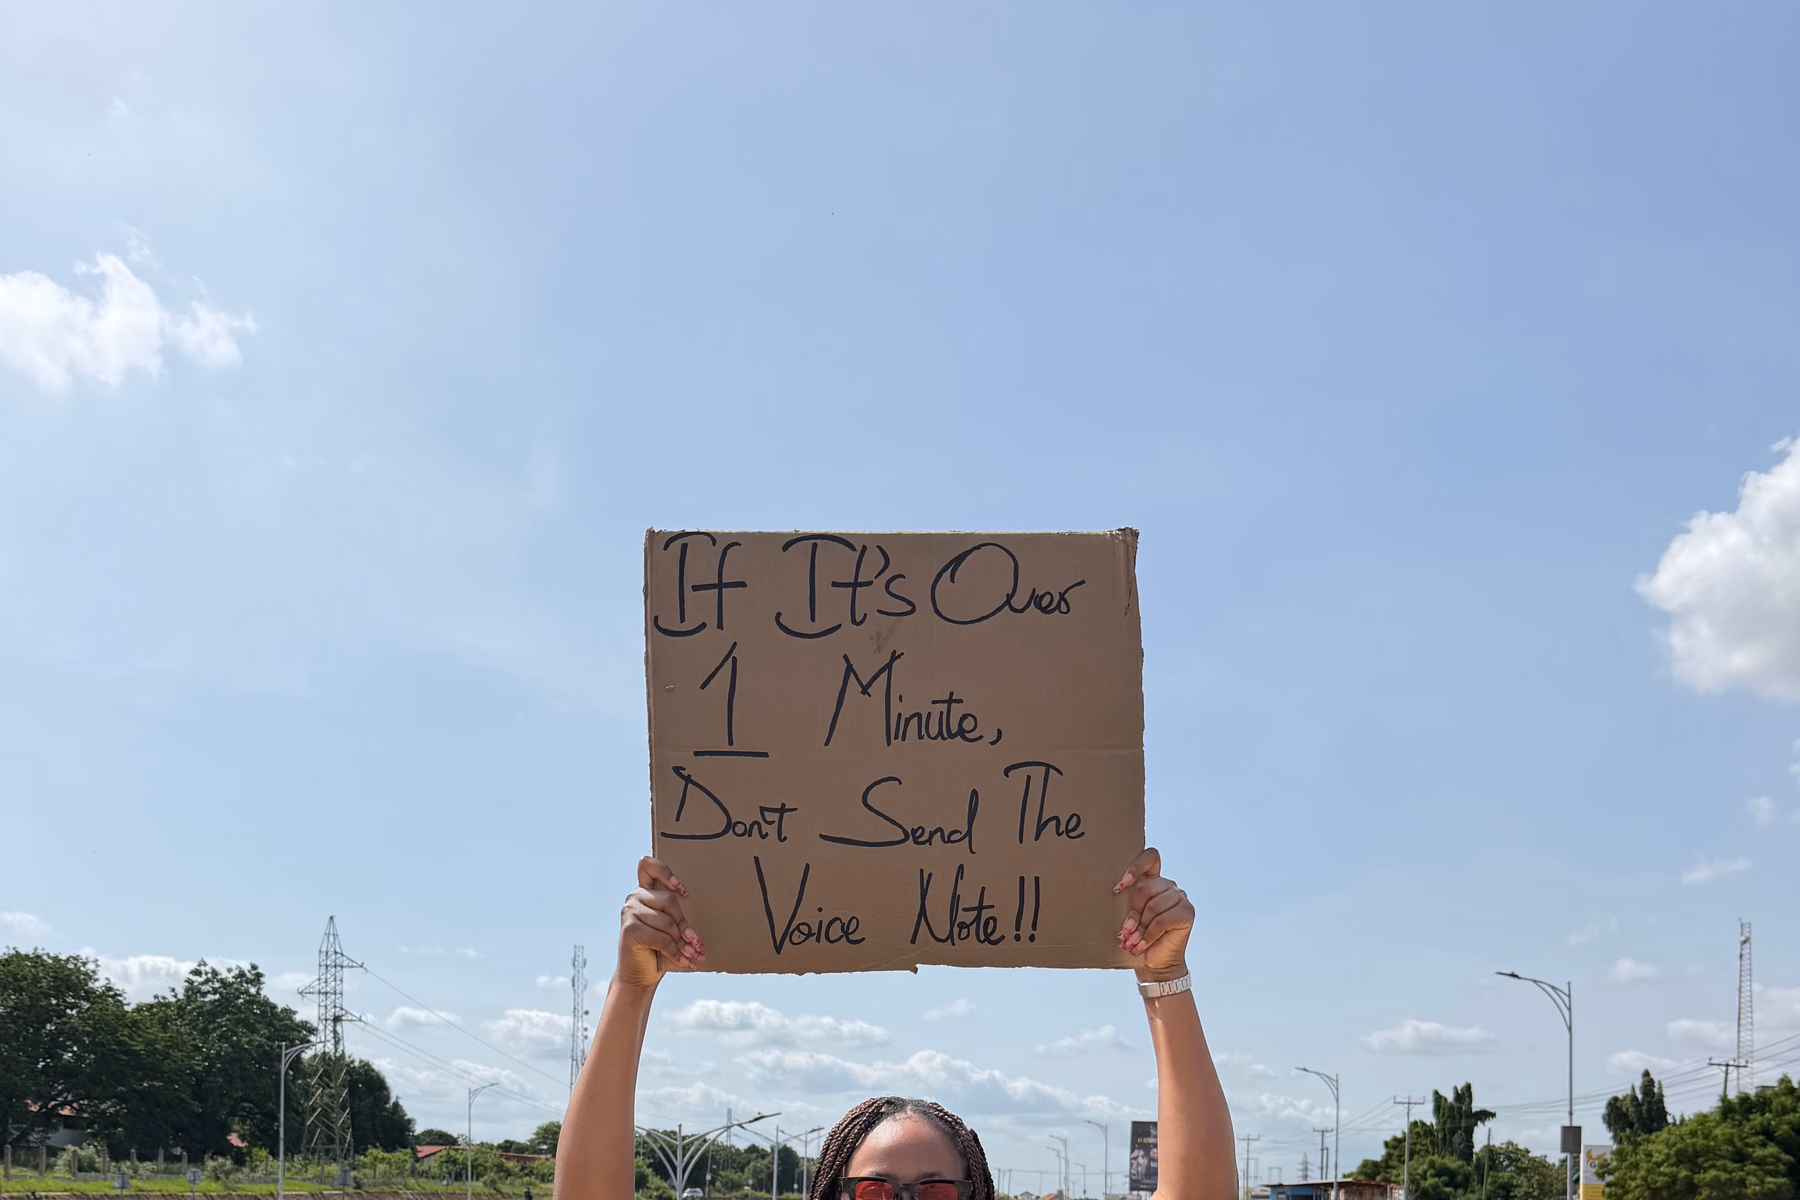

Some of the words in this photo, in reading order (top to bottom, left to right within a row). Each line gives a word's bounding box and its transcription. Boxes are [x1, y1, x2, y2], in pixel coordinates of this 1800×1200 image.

[654, 531, 747, 637] If
[775, 534, 916, 639] It's
[931, 543, 1086, 625] Over
[824, 650, 1002, 746] Minute,
[819, 776, 979, 854] Send
[1004, 761, 1085, 844] The
[754, 856, 865, 955] Voice
[910, 864, 1040, 946] Note!!
